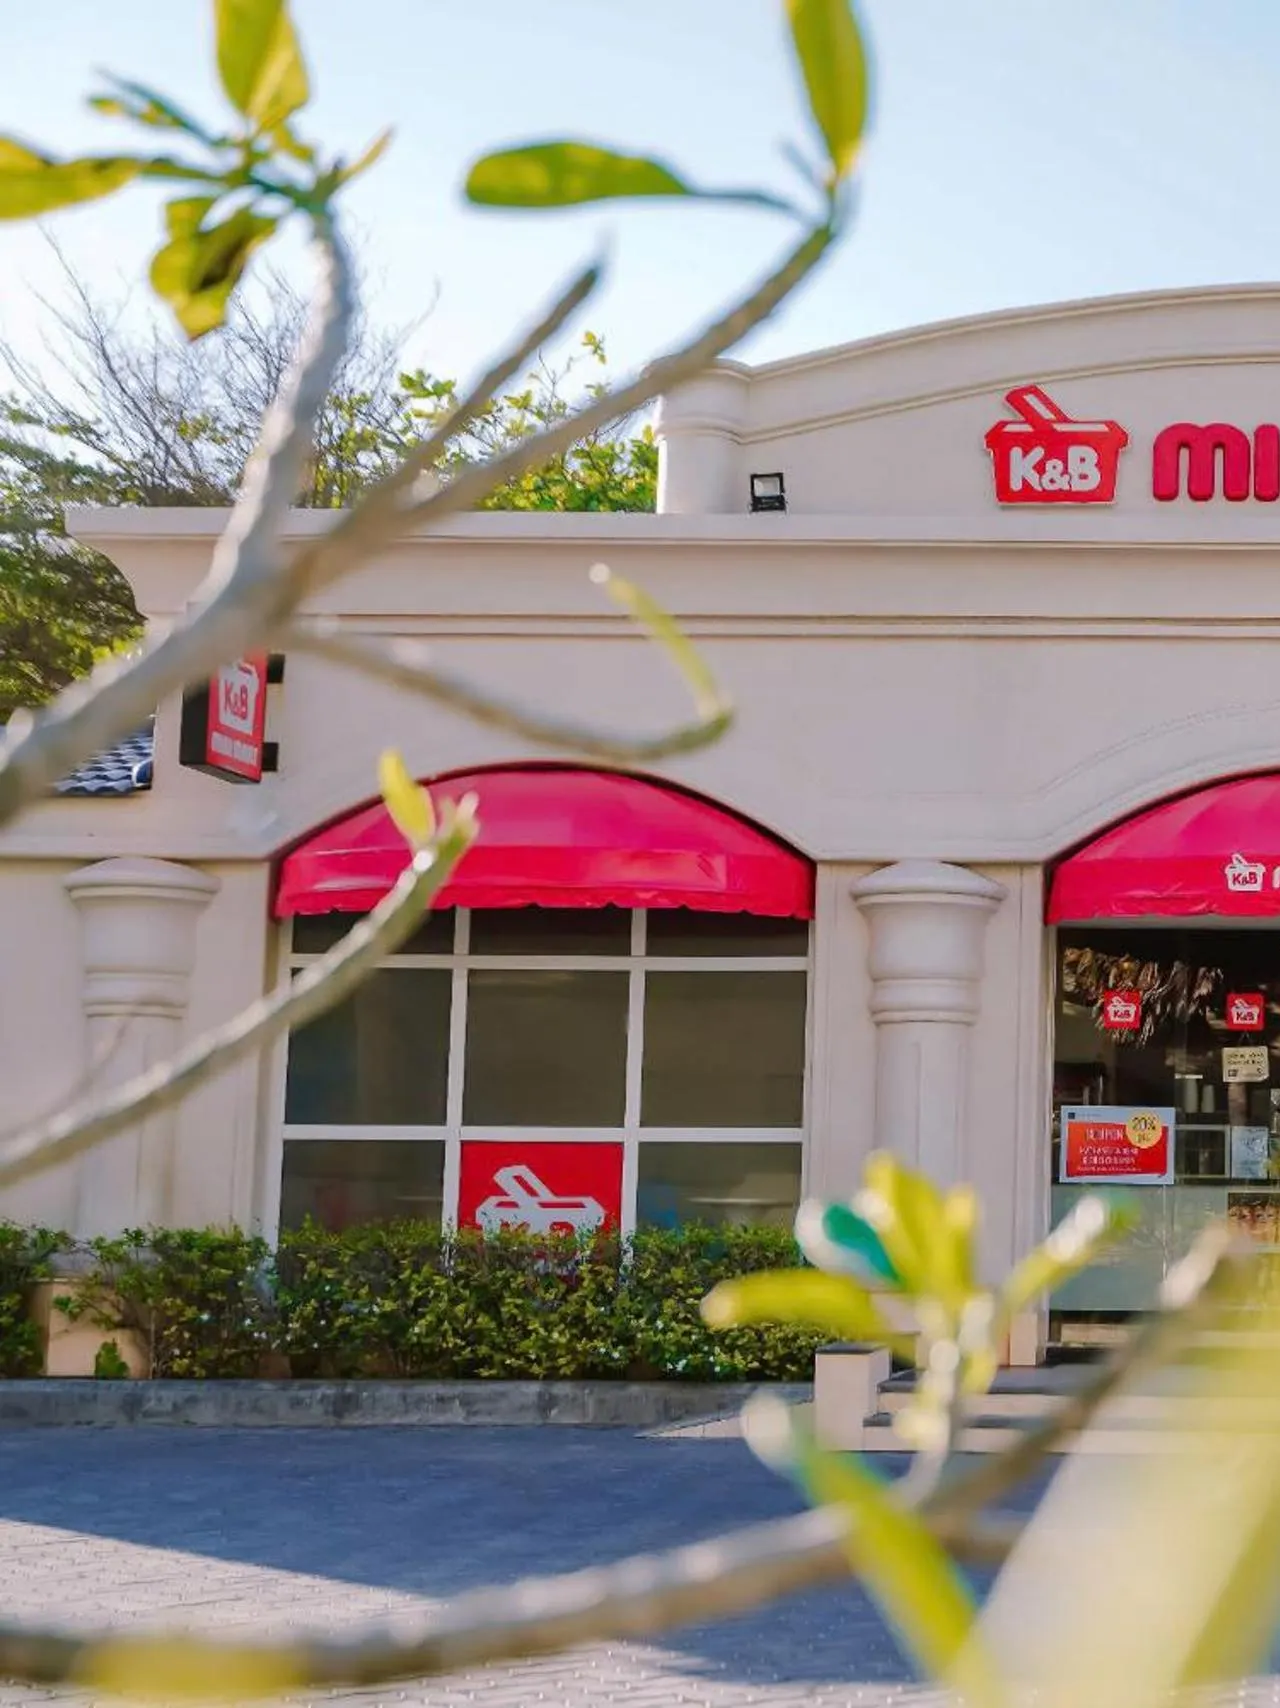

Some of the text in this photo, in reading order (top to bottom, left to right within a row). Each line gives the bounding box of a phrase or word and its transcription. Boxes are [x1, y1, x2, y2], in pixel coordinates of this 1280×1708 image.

[1009, 445, 1101, 492] K&B
[224, 678, 249, 721] K&B
[1232, 872, 1258, 887] K&B
